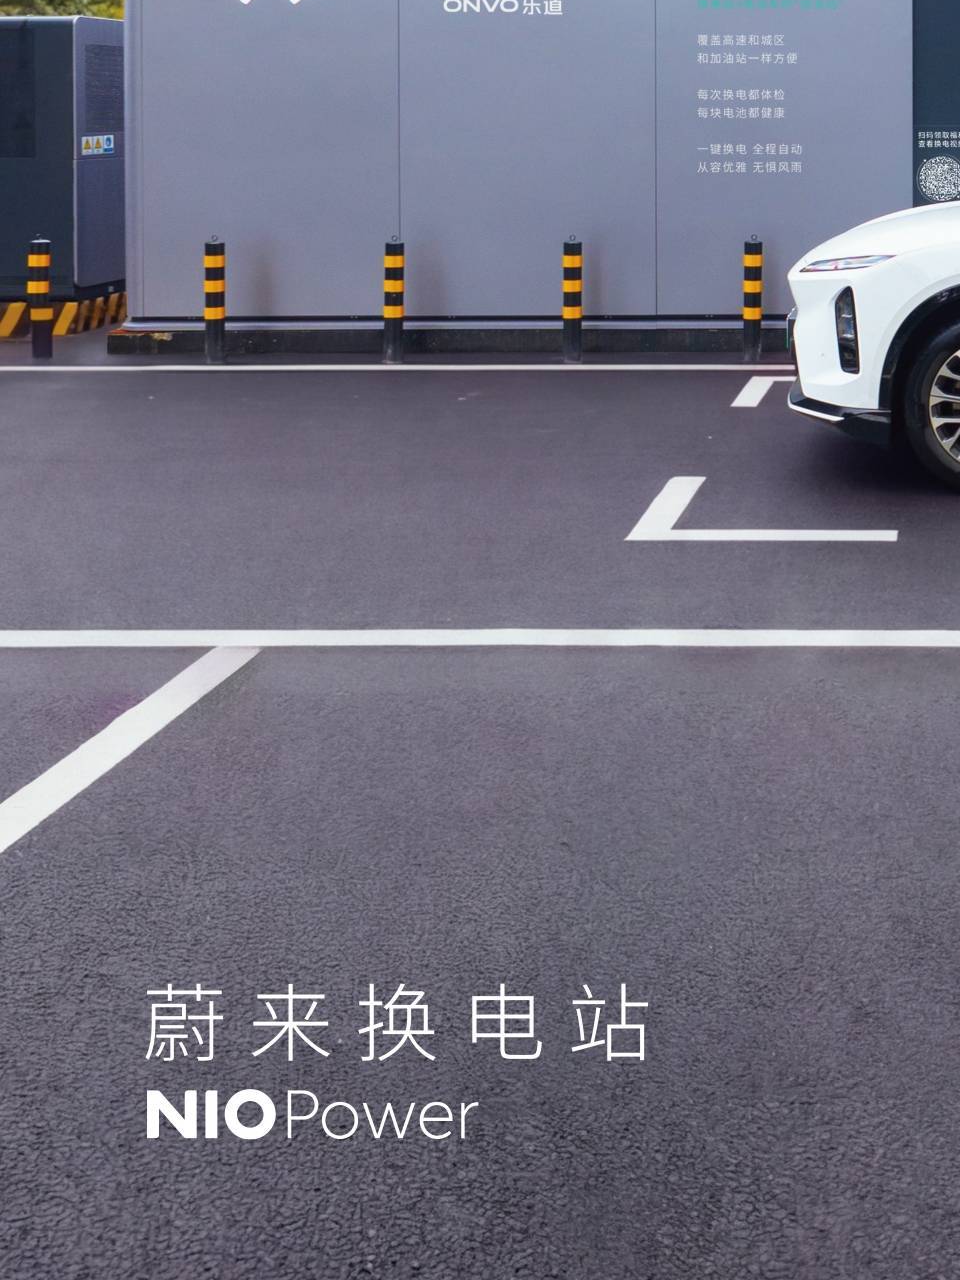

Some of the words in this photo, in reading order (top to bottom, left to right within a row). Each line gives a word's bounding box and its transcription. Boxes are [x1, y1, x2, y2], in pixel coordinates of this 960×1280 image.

[697, 34, 785, 46] 覆盖高速和城区
[697, 52, 798, 64] 和加油站一样方便
[697, 88, 785, 101] 每次换电都体检
[697, 106, 785, 119] 每块电池都健康
[697, 143, 747, 155] 一键换电
[752, 143, 802, 155] 全程自动
[697, 161, 747, 173] 从容优雅
[752, 161, 802, 173] 无惧风雨
